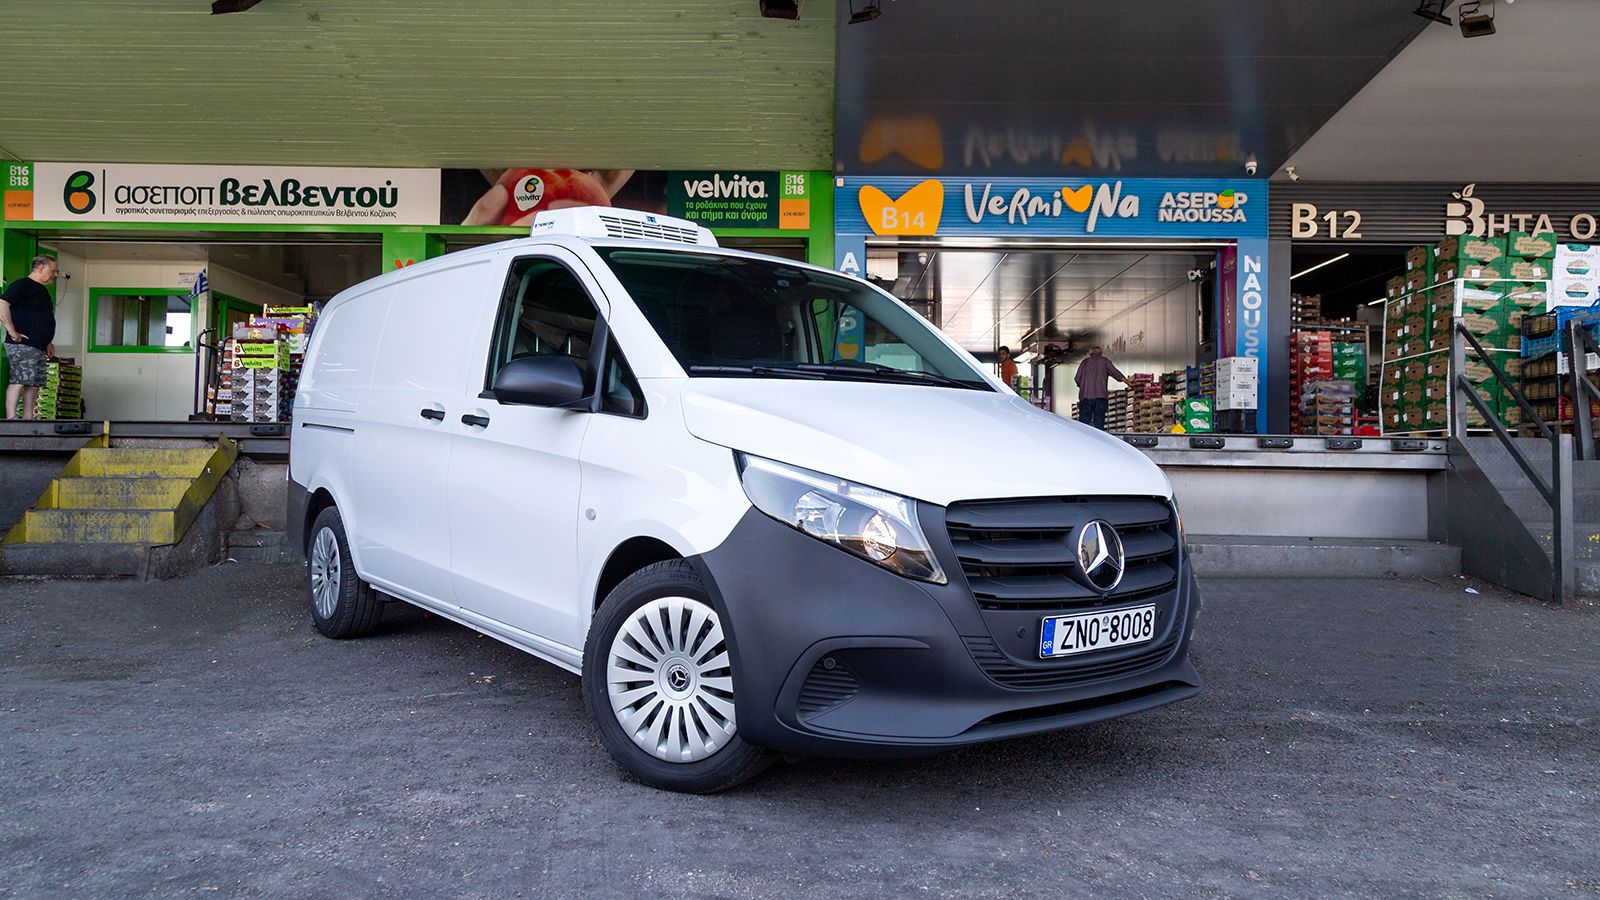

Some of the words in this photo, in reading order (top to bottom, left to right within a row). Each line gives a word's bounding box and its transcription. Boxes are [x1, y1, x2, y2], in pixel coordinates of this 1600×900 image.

[9, 165, 29, 176] B16
[9, 176, 29, 186] B18
[785, 174, 805, 185] B16
[114, 185, 215, 206] ασεποπ
[219, 177, 398, 208] βελβεντού
[785, 185, 805, 195] B18
[685, 201, 694, 209] τα
[695, 200, 729, 210] ροδάκινα
[730, 201, 744, 209] που
[745, 200, 768, 210] έχουν
[685, 211, 699, 220] και
[701, 210, 724, 221] σήμα
[725, 211, 739, 220] και
[740, 210, 768, 221] όνομα
[881, 207, 927, 230] B14
[1157, 208, 1247, 223] NAOUSSA
[1291, 202, 1363, 239] B12
[1042, 640, 1053, 650] GR
